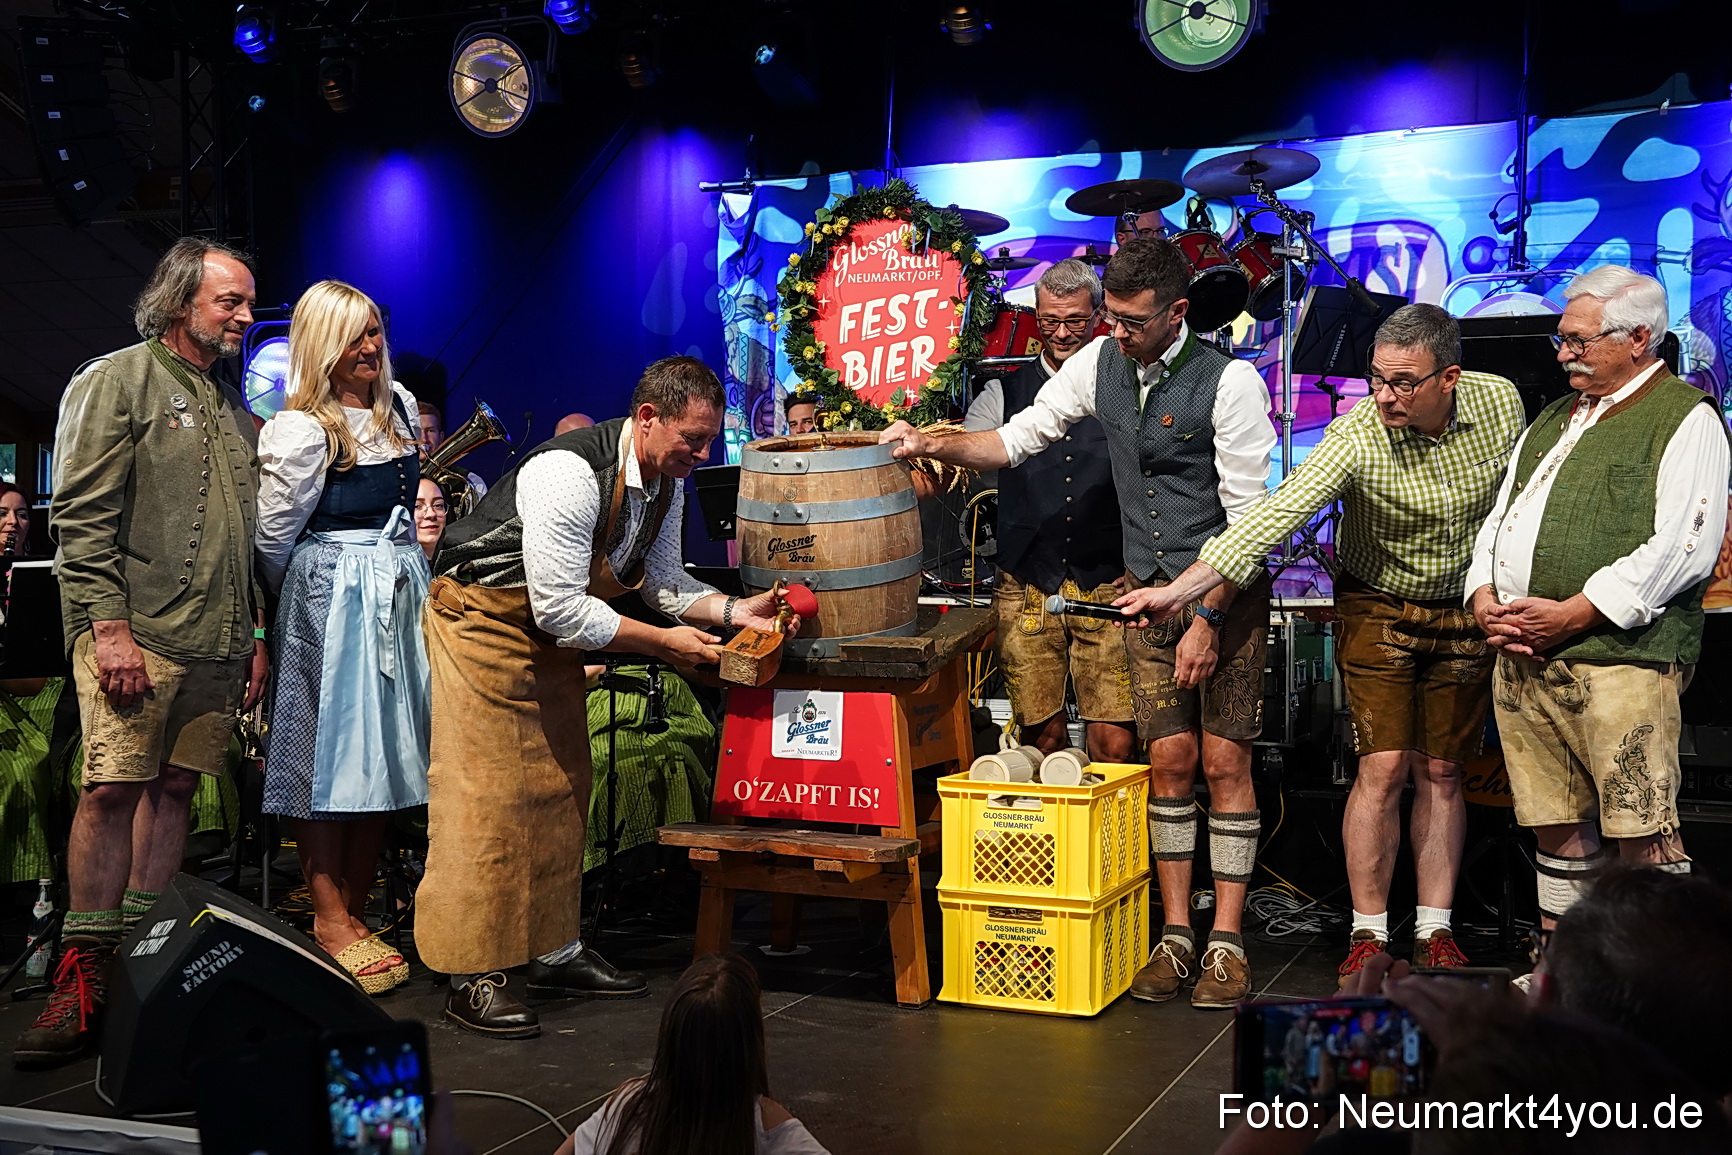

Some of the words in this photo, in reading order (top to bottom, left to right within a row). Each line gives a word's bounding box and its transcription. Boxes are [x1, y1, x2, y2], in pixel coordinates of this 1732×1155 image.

[833, 223, 916, 287] Glossne
[847, 270, 943, 283] NEUMARKT/OPF.
[839, 288, 949, 345] FEST-
[841, 335, 939, 391] BIER
[767, 534, 817, 561] Glossner
[788, 551, 815, 563] Bräu
[787, 719, 831, 743] Glossner
[806, 734, 829, 744] Bräu
[847, 786, 881, 809] IS!
[982, 811, 1045, 823] GLOSSNER-BRÄU
[993, 820, 1034, 830] NEUMARKT
[984, 924, 1047, 936] GLOSSNER-BRÄU
[995, 932, 1036, 943] NEUMARKT
[180, 944, 246, 994] FACTORY
[182, 940, 231, 979] SOUND
